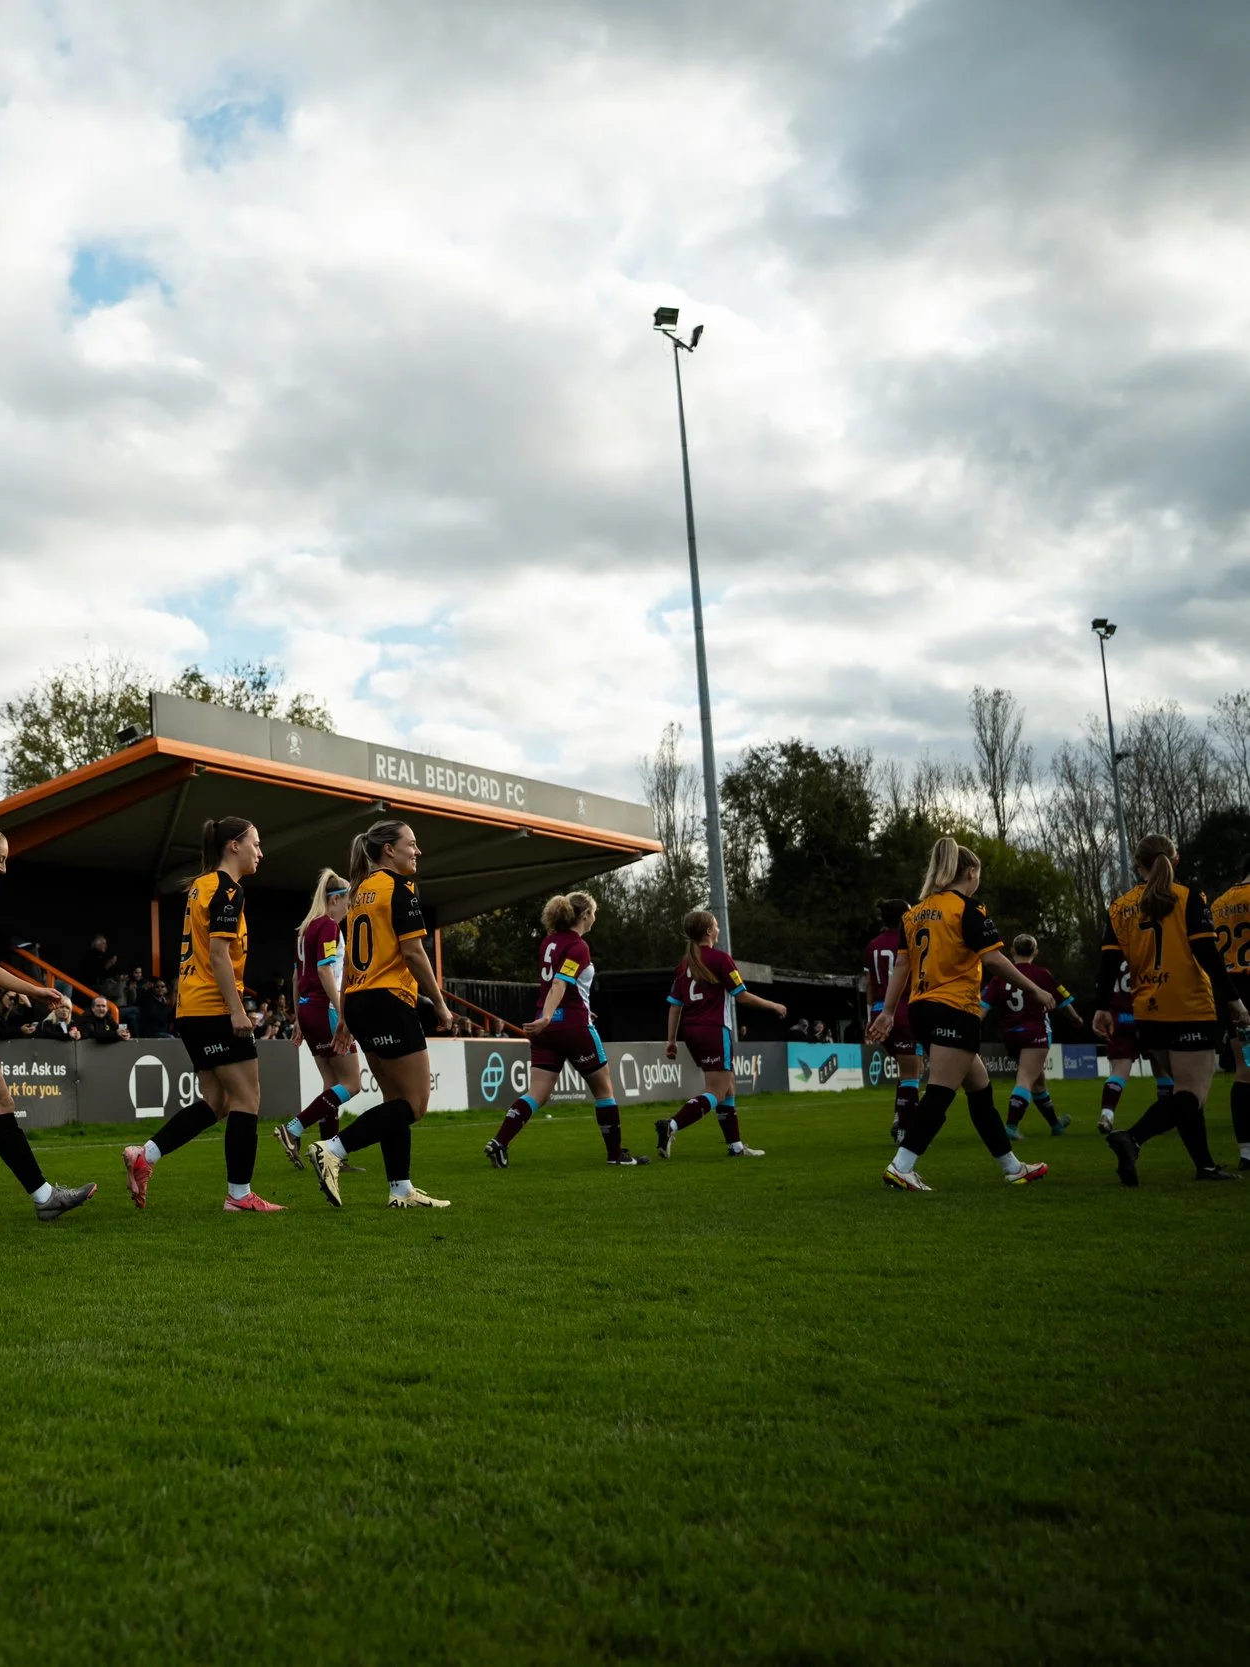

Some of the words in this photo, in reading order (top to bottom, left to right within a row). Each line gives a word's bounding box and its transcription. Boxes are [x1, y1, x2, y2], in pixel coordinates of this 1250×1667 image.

[376, 753, 420, 785] REAL
[425, 764, 500, 801] BEDFORD
[505, 782, 525, 806] FC
[1139, 920, 1163, 970] 7
[541, 942, 557, 982] 5
[873, 949, 895, 985] 17
[1005, 982, 1025, 1012] 3
[372, 1035, 393, 1047] PJH
[935, 1028, 957, 1038] PJH
[203, 1043, 224, 1056] PJH
[0, 1061, 10, 1076] is
[12, 1061, 29, 1076] ad.
[31, 1061, 51, 1076] Ask
[53, 1064, 67, 1076] us
[642, 1058, 682, 1090] galaxy
[732, 1054, 762, 1090] Wolf
[883, 1055, 900, 1079] GE
[9, 1082, 20, 1096] rk
[22, 1081, 39, 1096] for
[39, 1084, 62, 1099] you.
